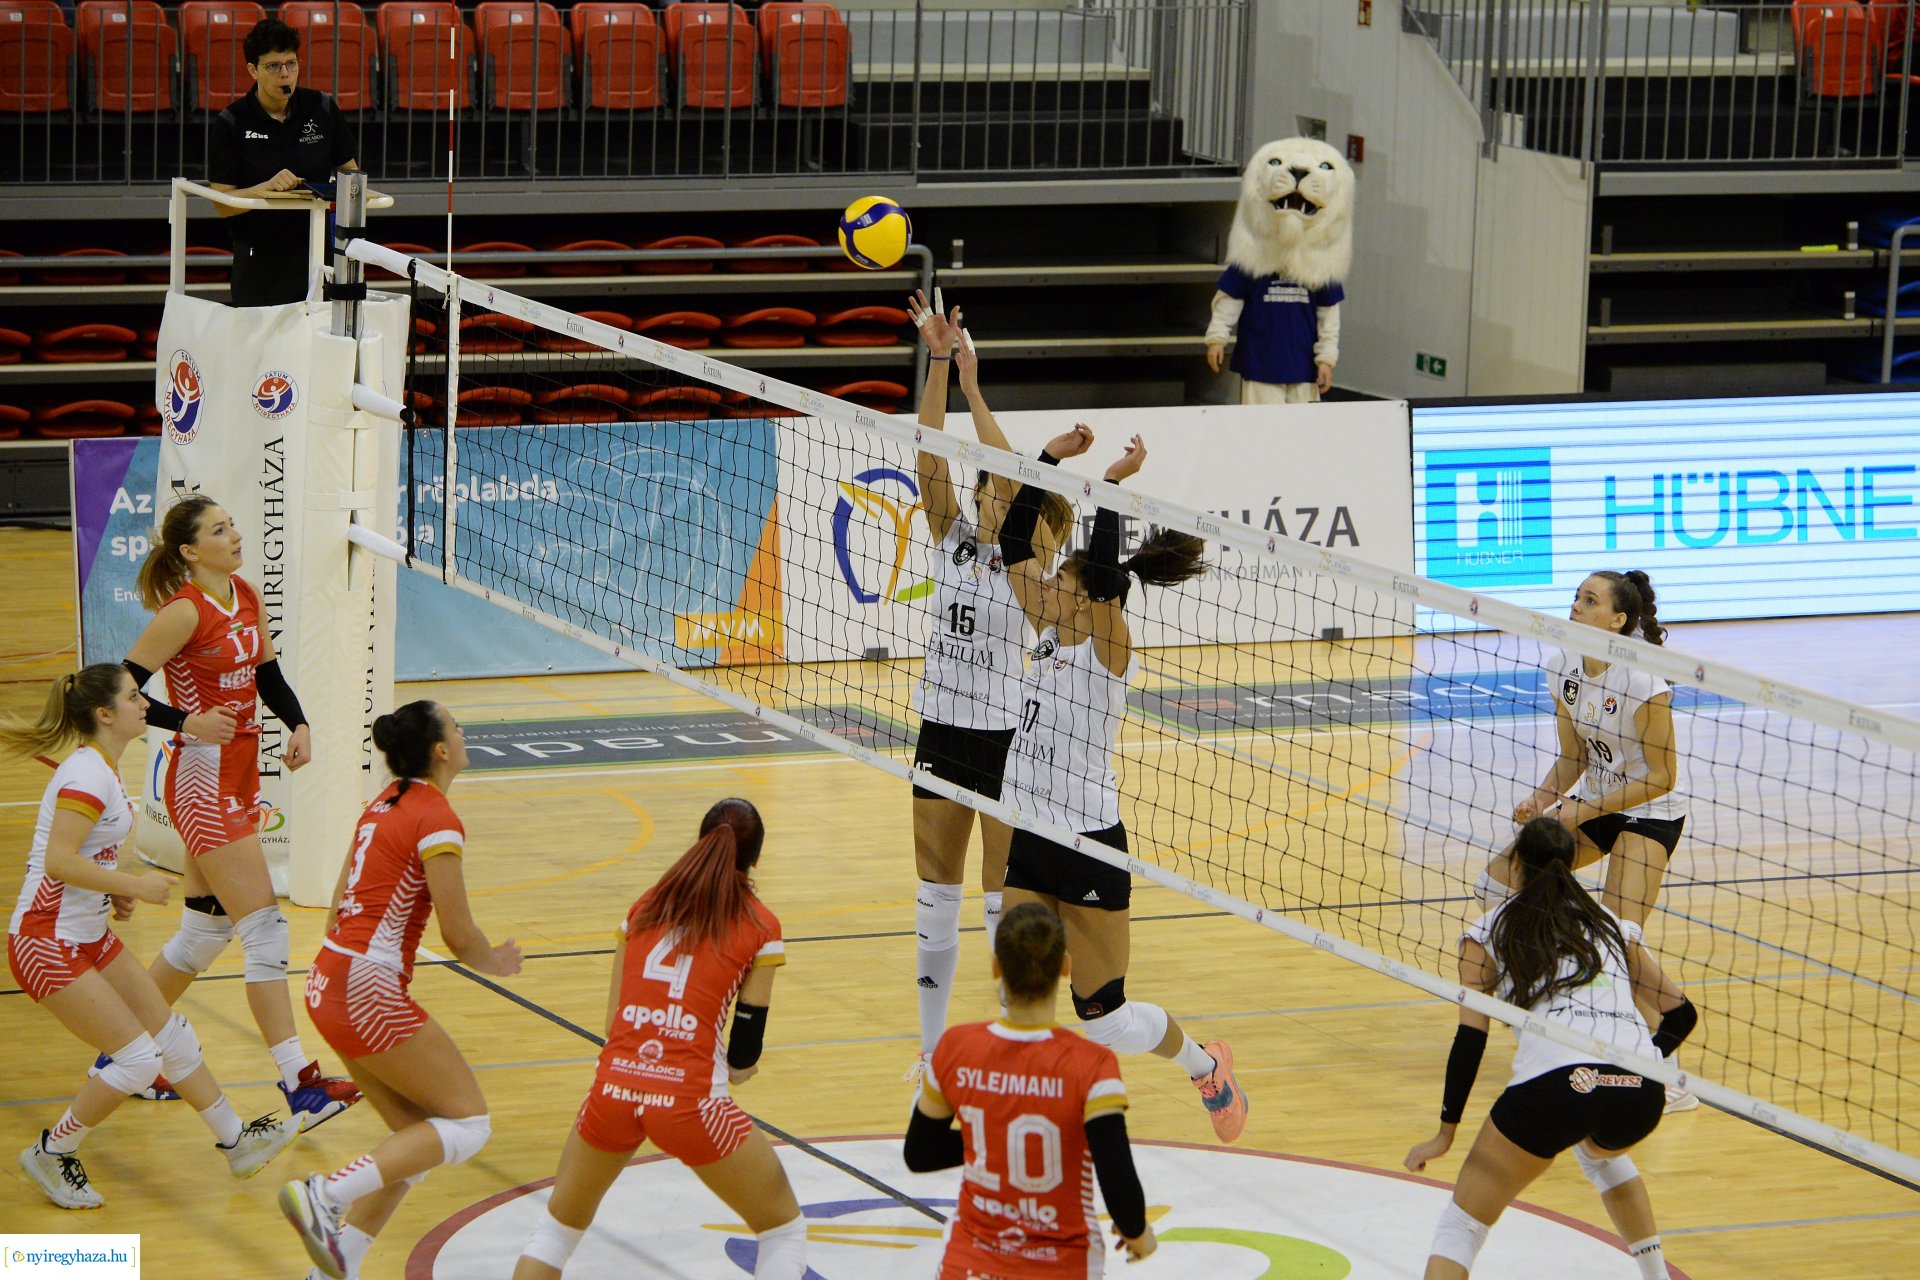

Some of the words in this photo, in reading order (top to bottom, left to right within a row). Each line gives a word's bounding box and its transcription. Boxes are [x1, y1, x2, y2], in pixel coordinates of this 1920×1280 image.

[109, 487, 153, 515] Az
[693, 617, 765, 642] MVM
[947, 602, 976, 637] 15
[226, 625, 260, 664] 17
[928, 631, 995, 668] FATUM
[1024, 698, 1041, 734] 17
[1588, 737, 1613, 764] 19
[642, 926, 694, 1000] 4
[622, 1003, 698, 1032] apollo
[658, 1027, 696, 1041] TYRES
[611, 1057, 686, 1078] SZABADICS
[956, 1066, 1064, 1098] SYLEJMANI
[958, 1105, 1064, 1194] 10
